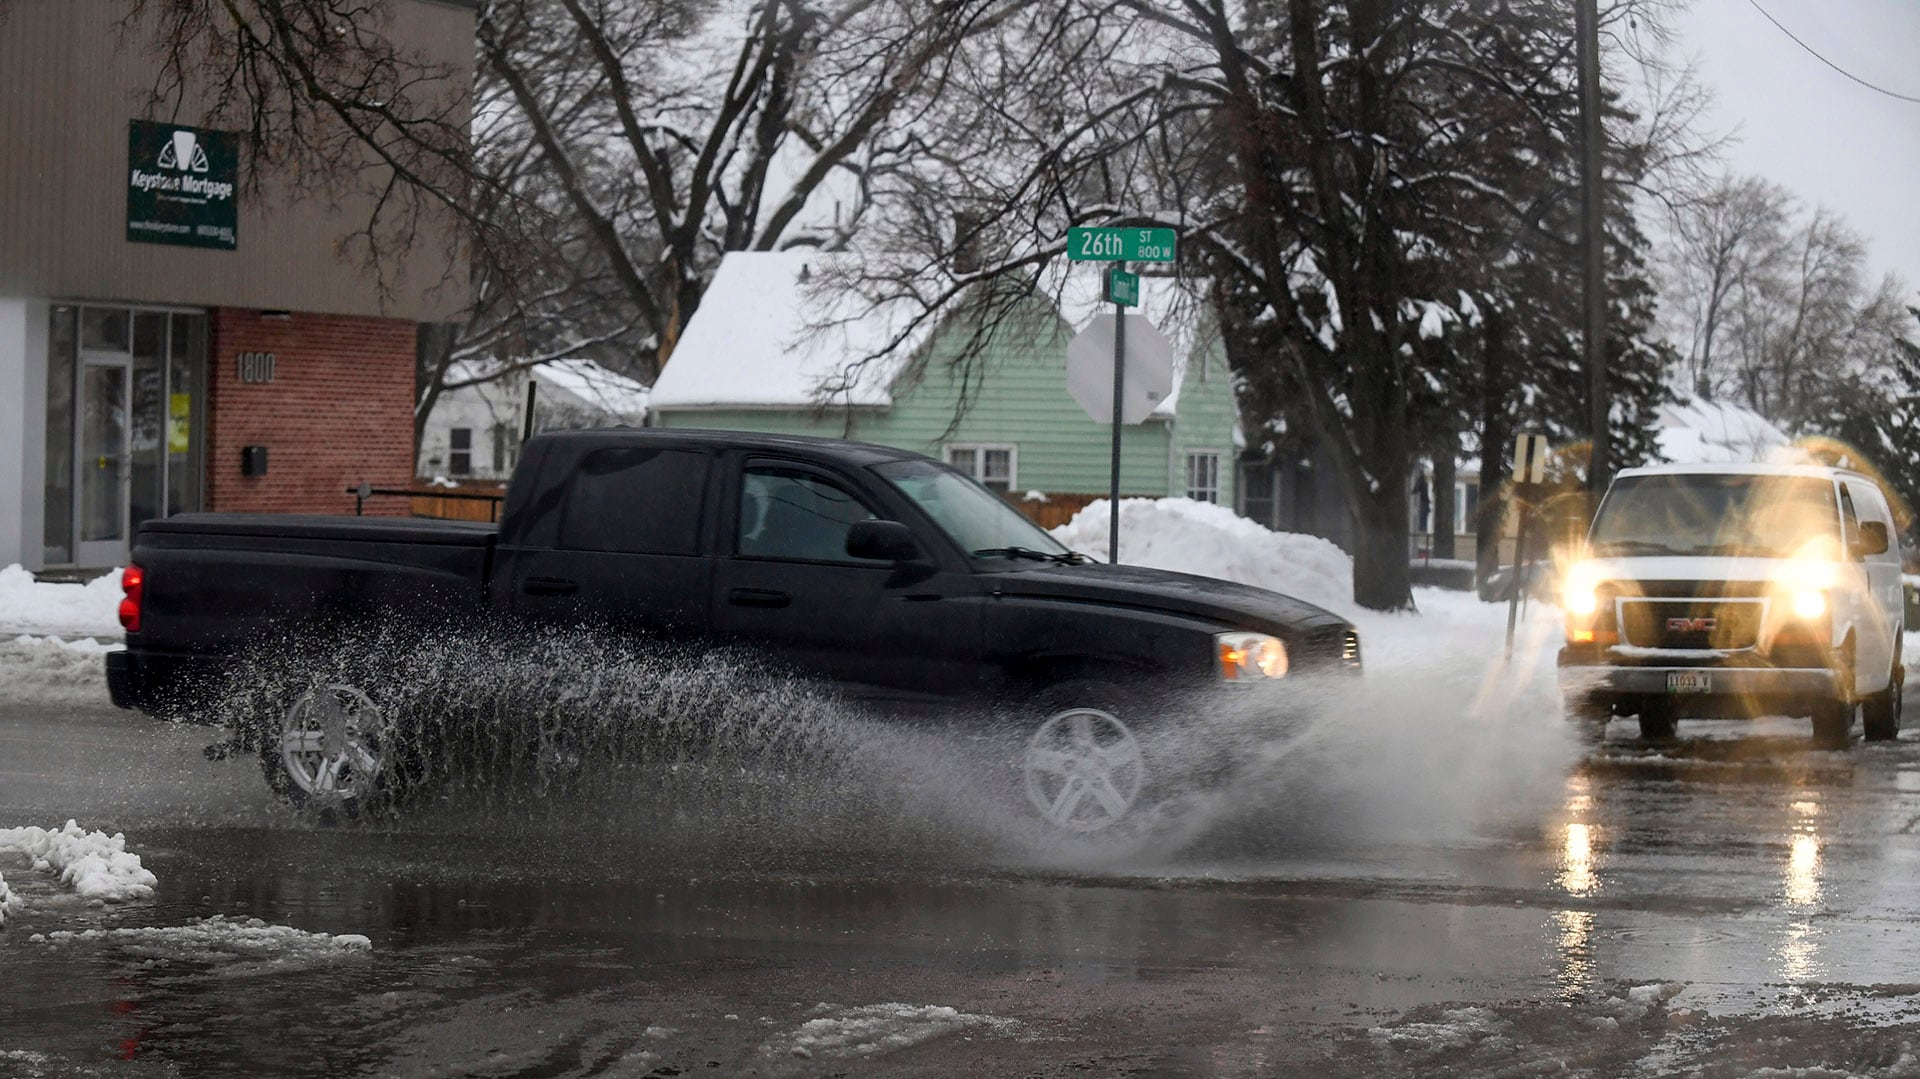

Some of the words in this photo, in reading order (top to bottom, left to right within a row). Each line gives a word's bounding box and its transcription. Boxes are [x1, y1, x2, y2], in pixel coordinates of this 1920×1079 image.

[182, 175, 232, 200] Mortgage
[1081, 232, 1122, 256] 26th
[1139, 230, 1152, 243] ST
[1138, 246, 1160, 258] 800
[1162, 246, 1171, 258] W
[237, 352, 275, 383] 1800
[1666, 617, 1717, 631] GMC
